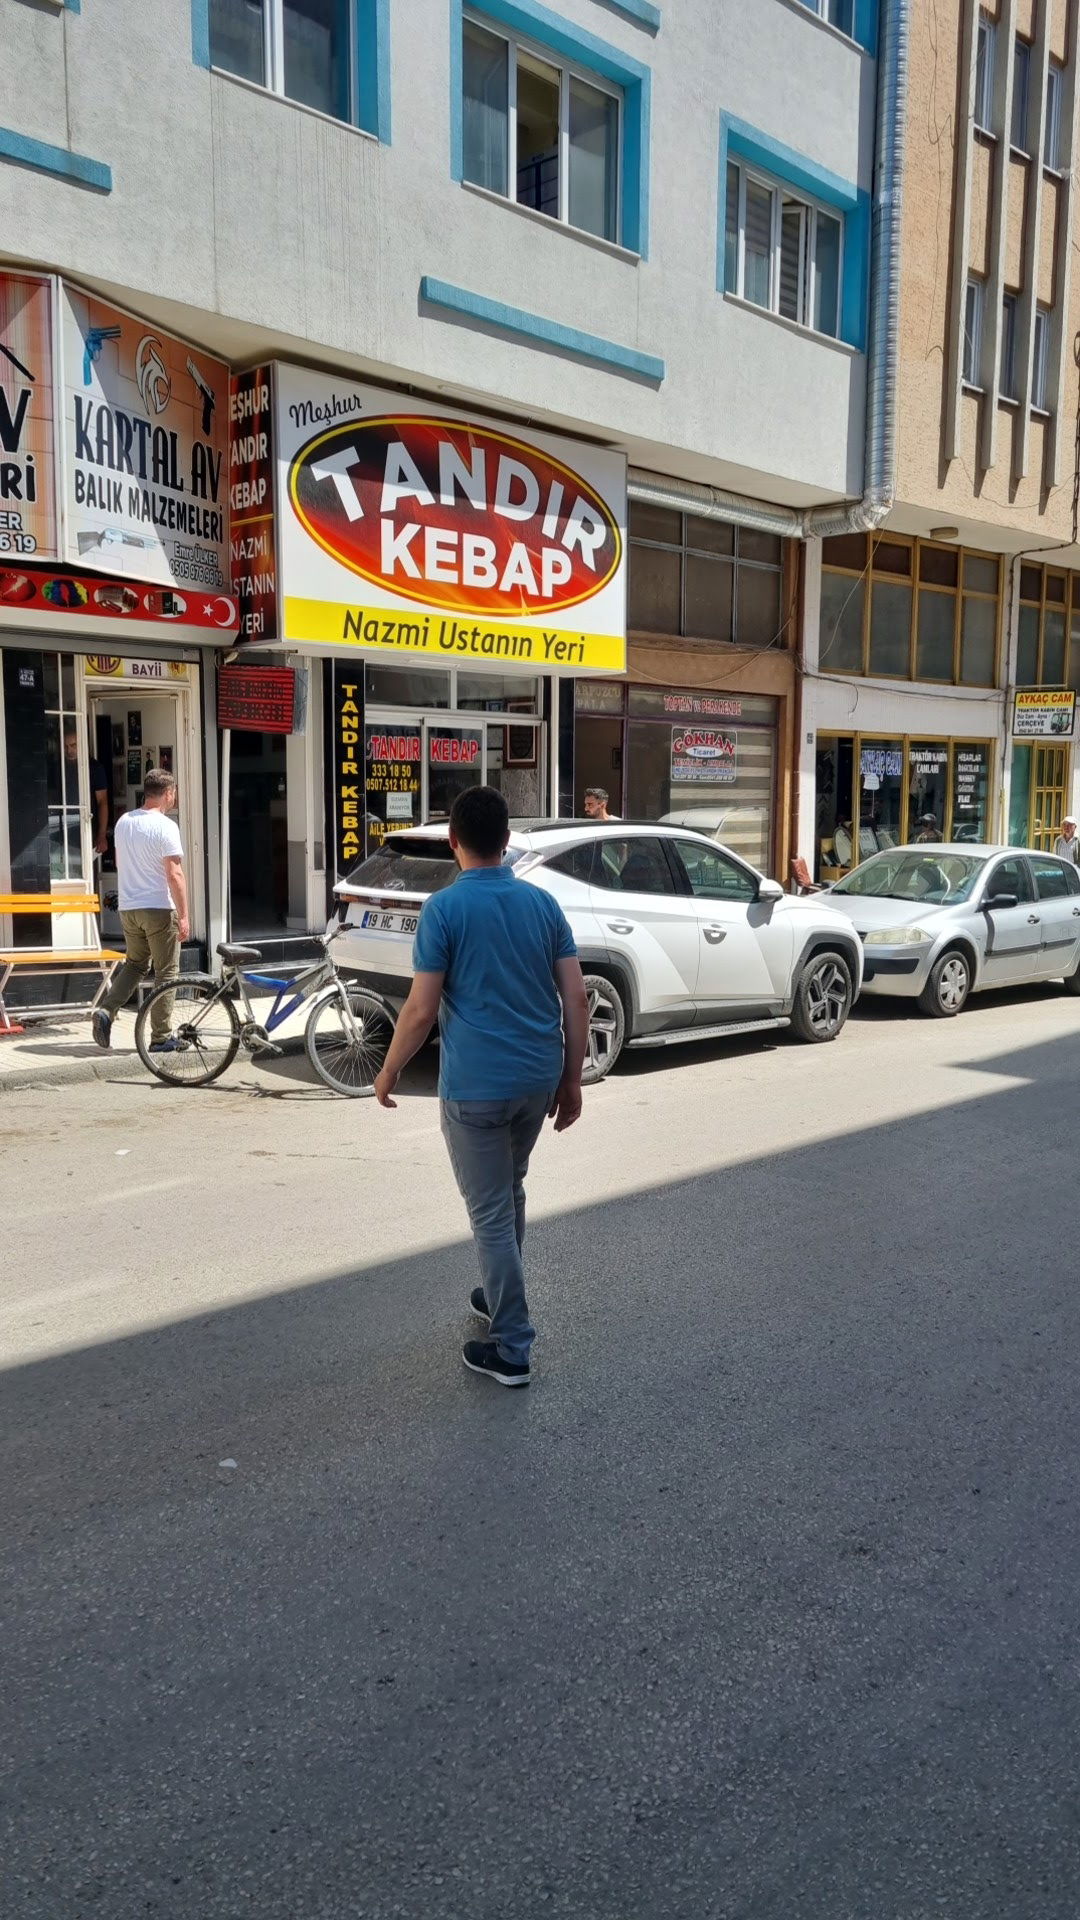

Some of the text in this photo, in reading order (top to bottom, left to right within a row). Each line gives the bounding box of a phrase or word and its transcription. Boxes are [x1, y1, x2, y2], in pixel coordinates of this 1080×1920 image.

[230, 385, 269, 424] EŞHUR
[289, 393, 362, 427] Meşhur
[74, 394, 222, 503] KARTAL AV
[230, 432, 267, 467] ANDIR
[75, 469, 223, 544] BALIK MALZEMELERİ
[310, 441, 607, 572] TANDIR
[15, 534, 36, 553] 19
[174, 541, 218, 567] Emre ÜLKER
[231, 531, 267, 561] NAZMİ
[169, 559, 189, 578] 0505
[380, 519, 572, 599] KEBAP
[343, 610, 585, 662] Nazmi Ustanın Yeri
[663, 694, 693, 712] TOPTAN
[1018, 693, 1072, 705] AYKAÇ CAM
[371, 735, 479, 763] TANDIR KEBAP
[674, 730, 736, 757] GÖKHAN
[341, 684, 359, 860] TANDIR KEBAP
[372, 764, 411, 777] 333 18 50
[367, 913, 417, 932] 19 HC 190
